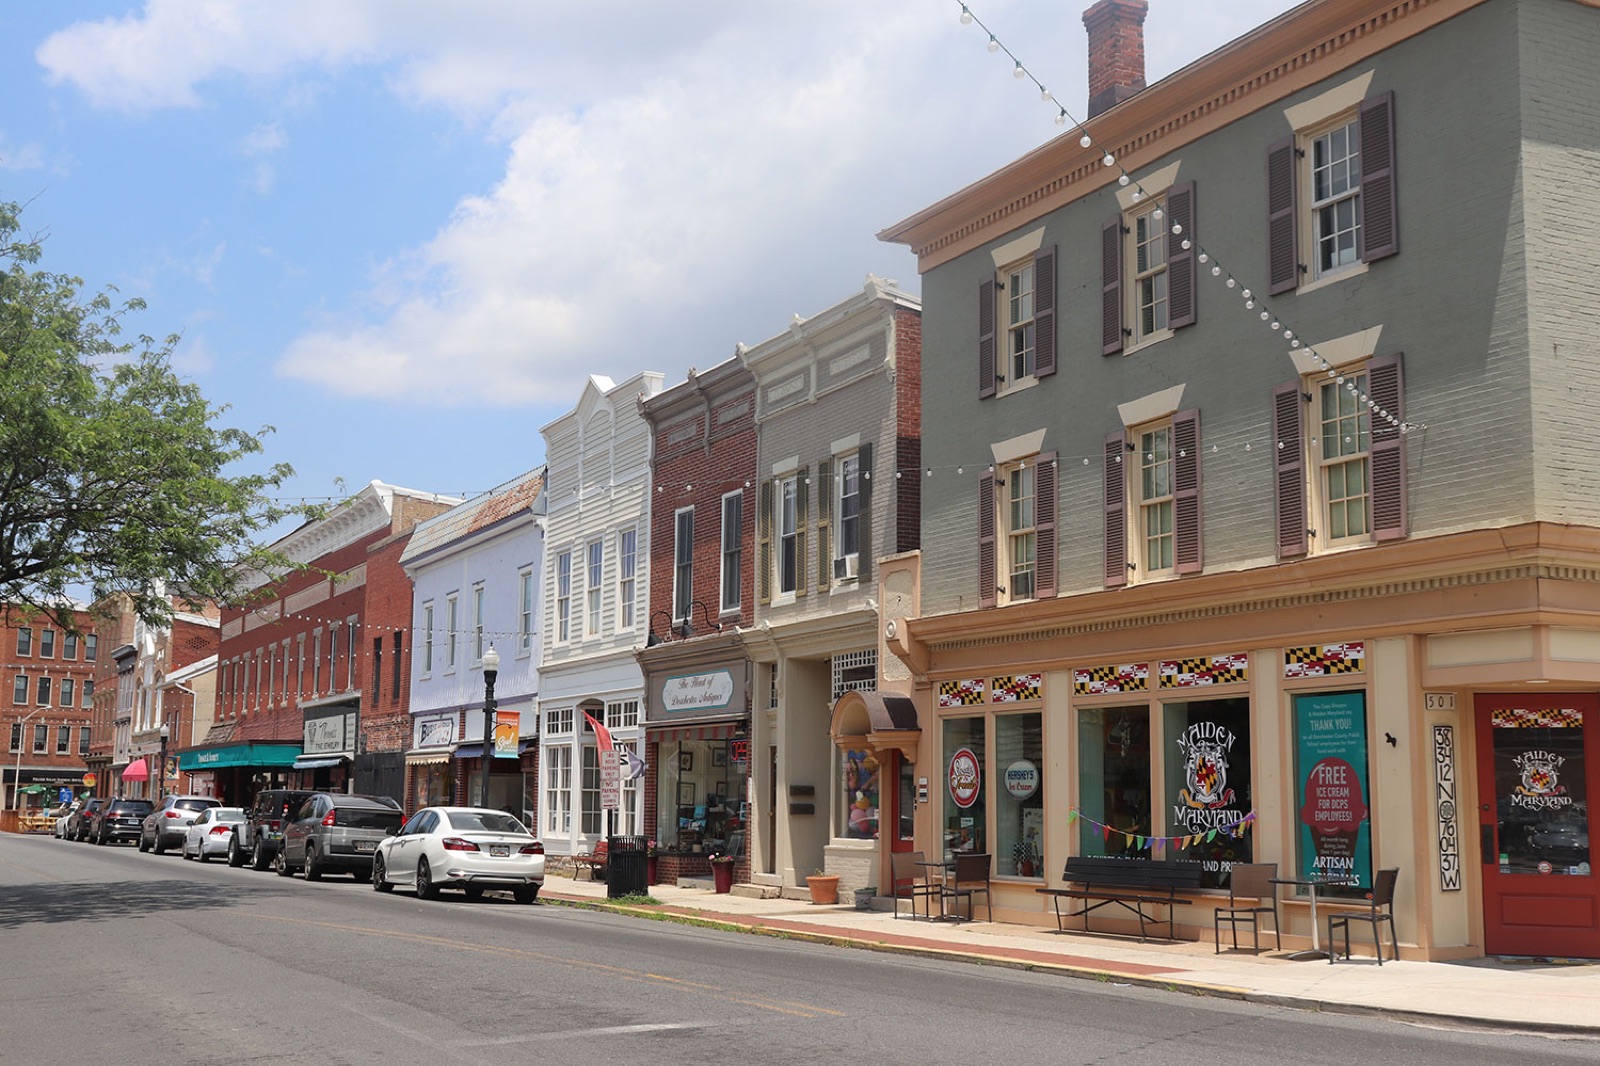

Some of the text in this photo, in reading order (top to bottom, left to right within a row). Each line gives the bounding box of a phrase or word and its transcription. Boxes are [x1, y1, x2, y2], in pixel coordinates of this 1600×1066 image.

[1310, 718, 1352, 731] THANK YOU!
[1176, 721, 1237, 755] MAIDEN
[1436, 728, 1451, 747] 38
[1512, 750, 1566, 768] MAIDEN
[1007, 770, 1035, 780] HERSHEY'S
[1319, 766, 1347, 785] FREE
[1017, 782, 1033, 791] Cream
[1316, 787, 1350, 798] ICE CREAM
[1318, 799, 1349, 810] FOR DCPS
[1510, 794, 1573, 811] MARYLAND
[1173, 805, 1244, 835] MARYLAND
[1314, 810, 1353, 822] EMPLOYEES!
[1312, 856, 1355, 869] ARTISAN
